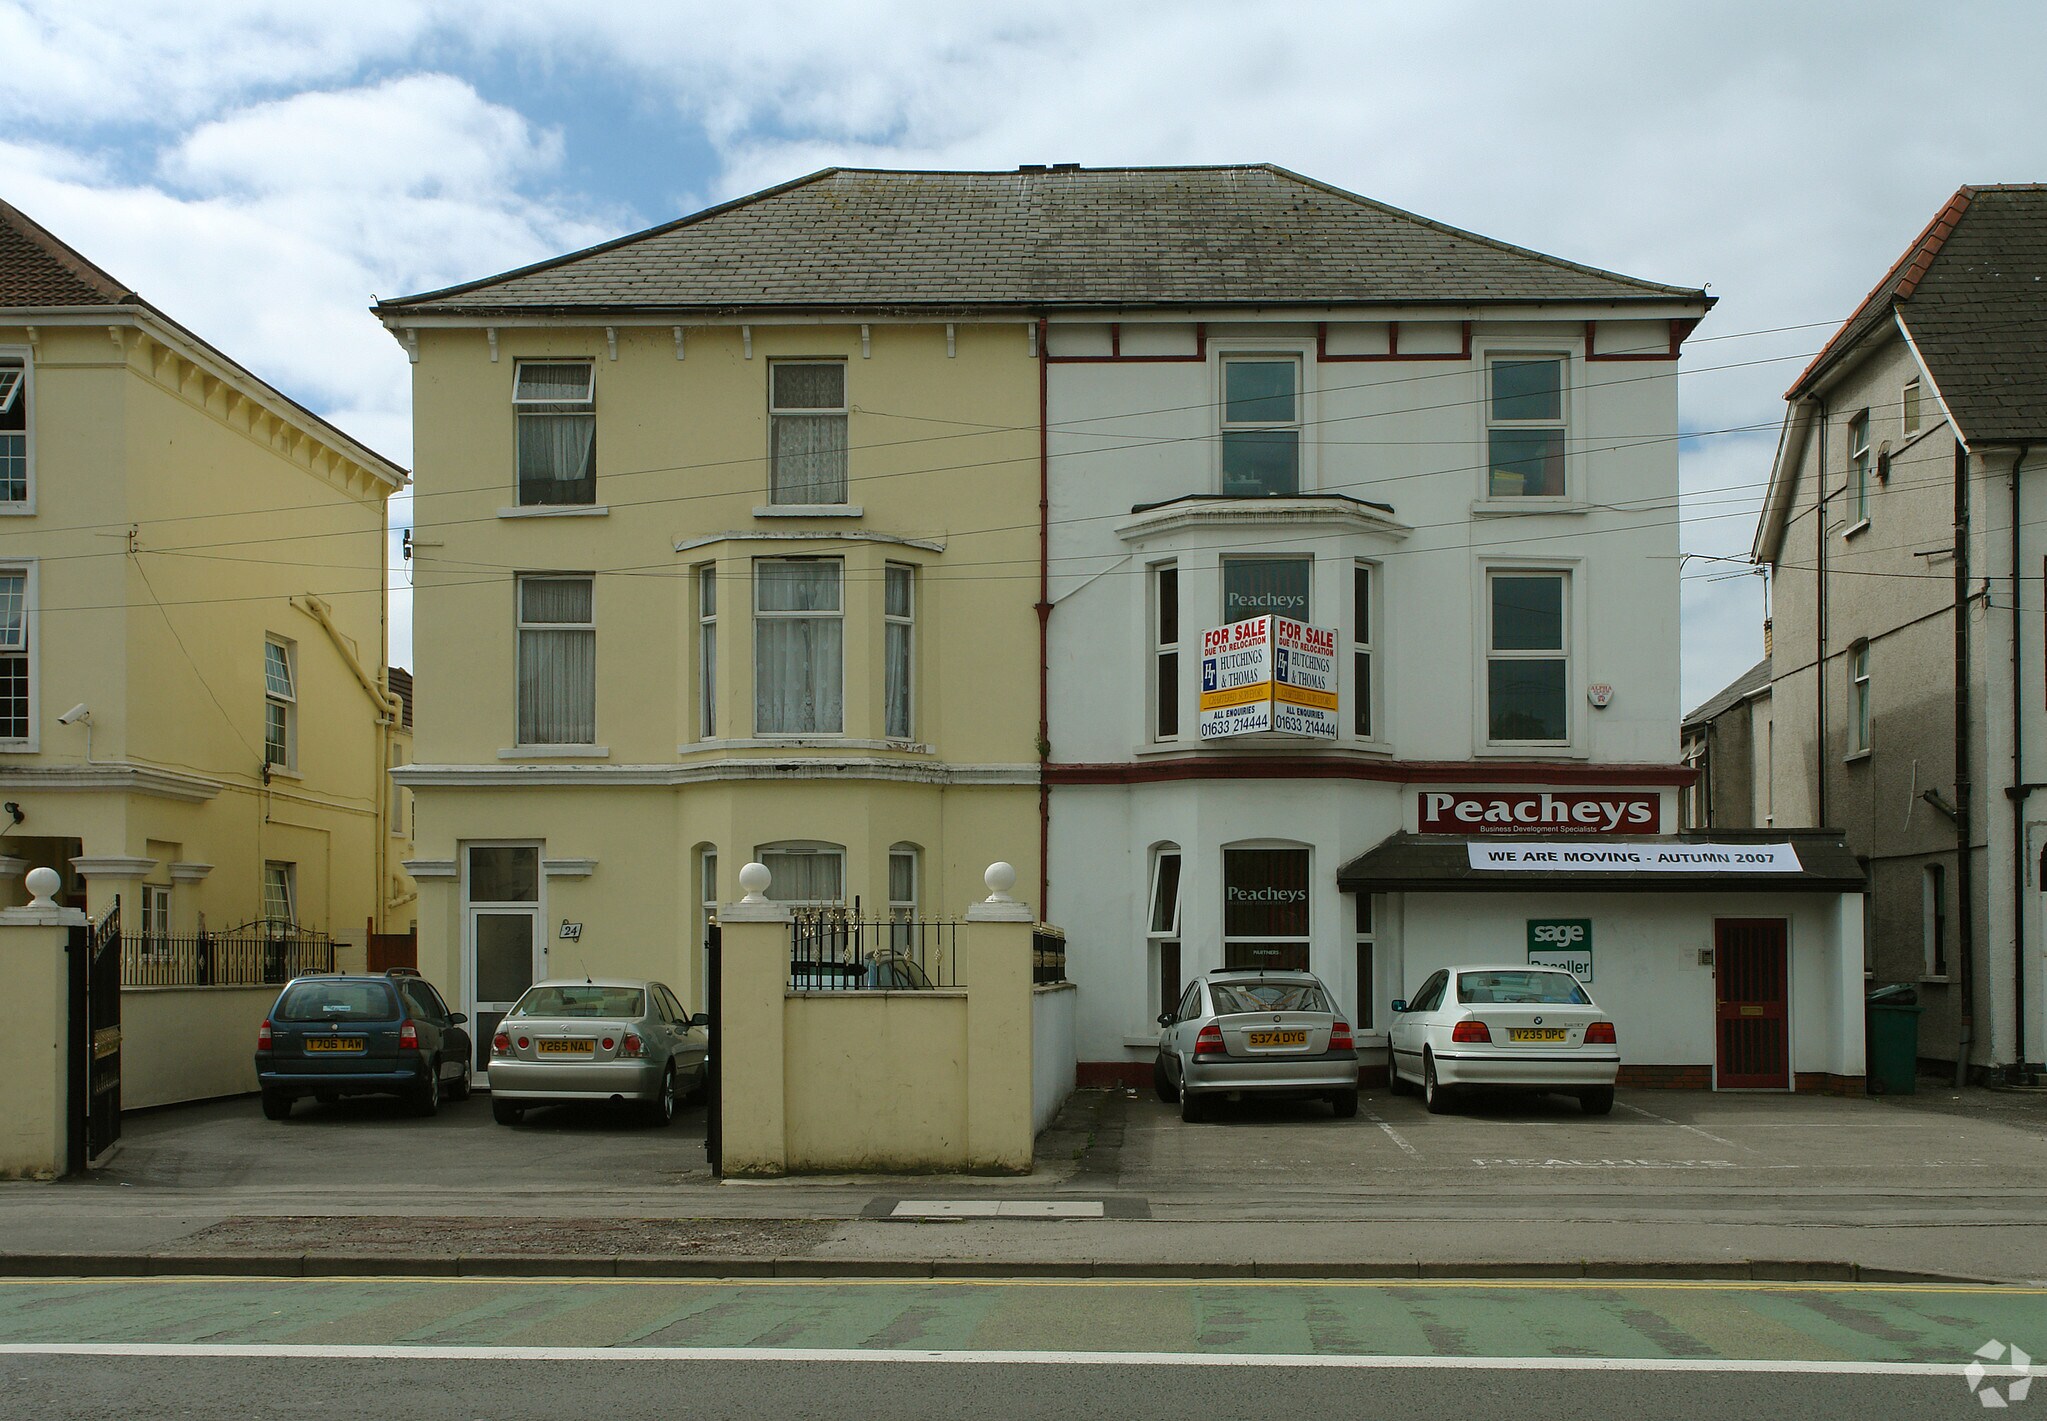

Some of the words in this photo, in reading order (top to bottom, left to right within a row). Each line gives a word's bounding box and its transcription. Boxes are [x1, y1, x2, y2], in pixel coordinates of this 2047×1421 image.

[1228, 592, 1305, 608] Peacheys
[1205, 628, 1229, 647] FOR
[1235, 619, 1266, 641] SALE
[1279, 620, 1301, 641] FOR
[1306, 627, 1333, 648] SALE
[1204, 647, 1216, 656] DUE
[1219, 645, 1227, 653] TO
[1229, 636, 1266, 651] RELOCATION
[1278, 637, 1290, 647] DUE
[1292, 640, 1299, 649] TO
[1300, 642, 1334, 657] RELOCATION
[1220, 648, 1263, 670] HUTCHINGS
[1291, 651, 1330, 673] HUTCHINGS
[1221, 674, 1227, 688] &
[1228, 668, 1258, 687] THOMAS
[1291, 670, 1296, 684] &
[1298, 671, 1326, 690] THOMAS
[1213, 711, 1224, 719] ALL
[1226, 705, 1255, 718] ENQUIRIES
[1286, 706, 1295, 715] ALL
[1297, 707, 1324, 719] ENQUIRIES
[1201, 720, 1230, 737] 01633
[1233, 714, 1268, 732] 214444
[1276, 714, 1302, 731] 01633
[1305, 720, 1335, 737] 214444
[1425, 793, 1652, 831] Peacheys
[1480, 825, 1512, 833] Business
[1513, 825, 1558, 834] Development
[1560, 825, 1597, 834] Specialists
[1488, 852, 1517, 862] WE
[1522, 852, 1558, 862] ARE
[1564, 852, 1641, 863] MOVING
[1658, 853, 1730, 863] AUTUMN
[1734, 853, 1775, 863] 2007
[1227, 886, 1306, 903] Peacheys
[564, 926, 577, 936] 24
[1534, 925, 1584, 947] sage
[308, 1039, 338, 1049] T706
[340, 1039, 362, 1049] TAW
[1250, 1033, 1280, 1044] S374
[1283, 1032, 1305, 1043] DYG
[1514, 1029, 1543, 1040] V235
[1545, 1029, 1565, 1039] DPC
[539, 1041, 568, 1051] Y265
[570, 1041, 591, 1051] NAL
